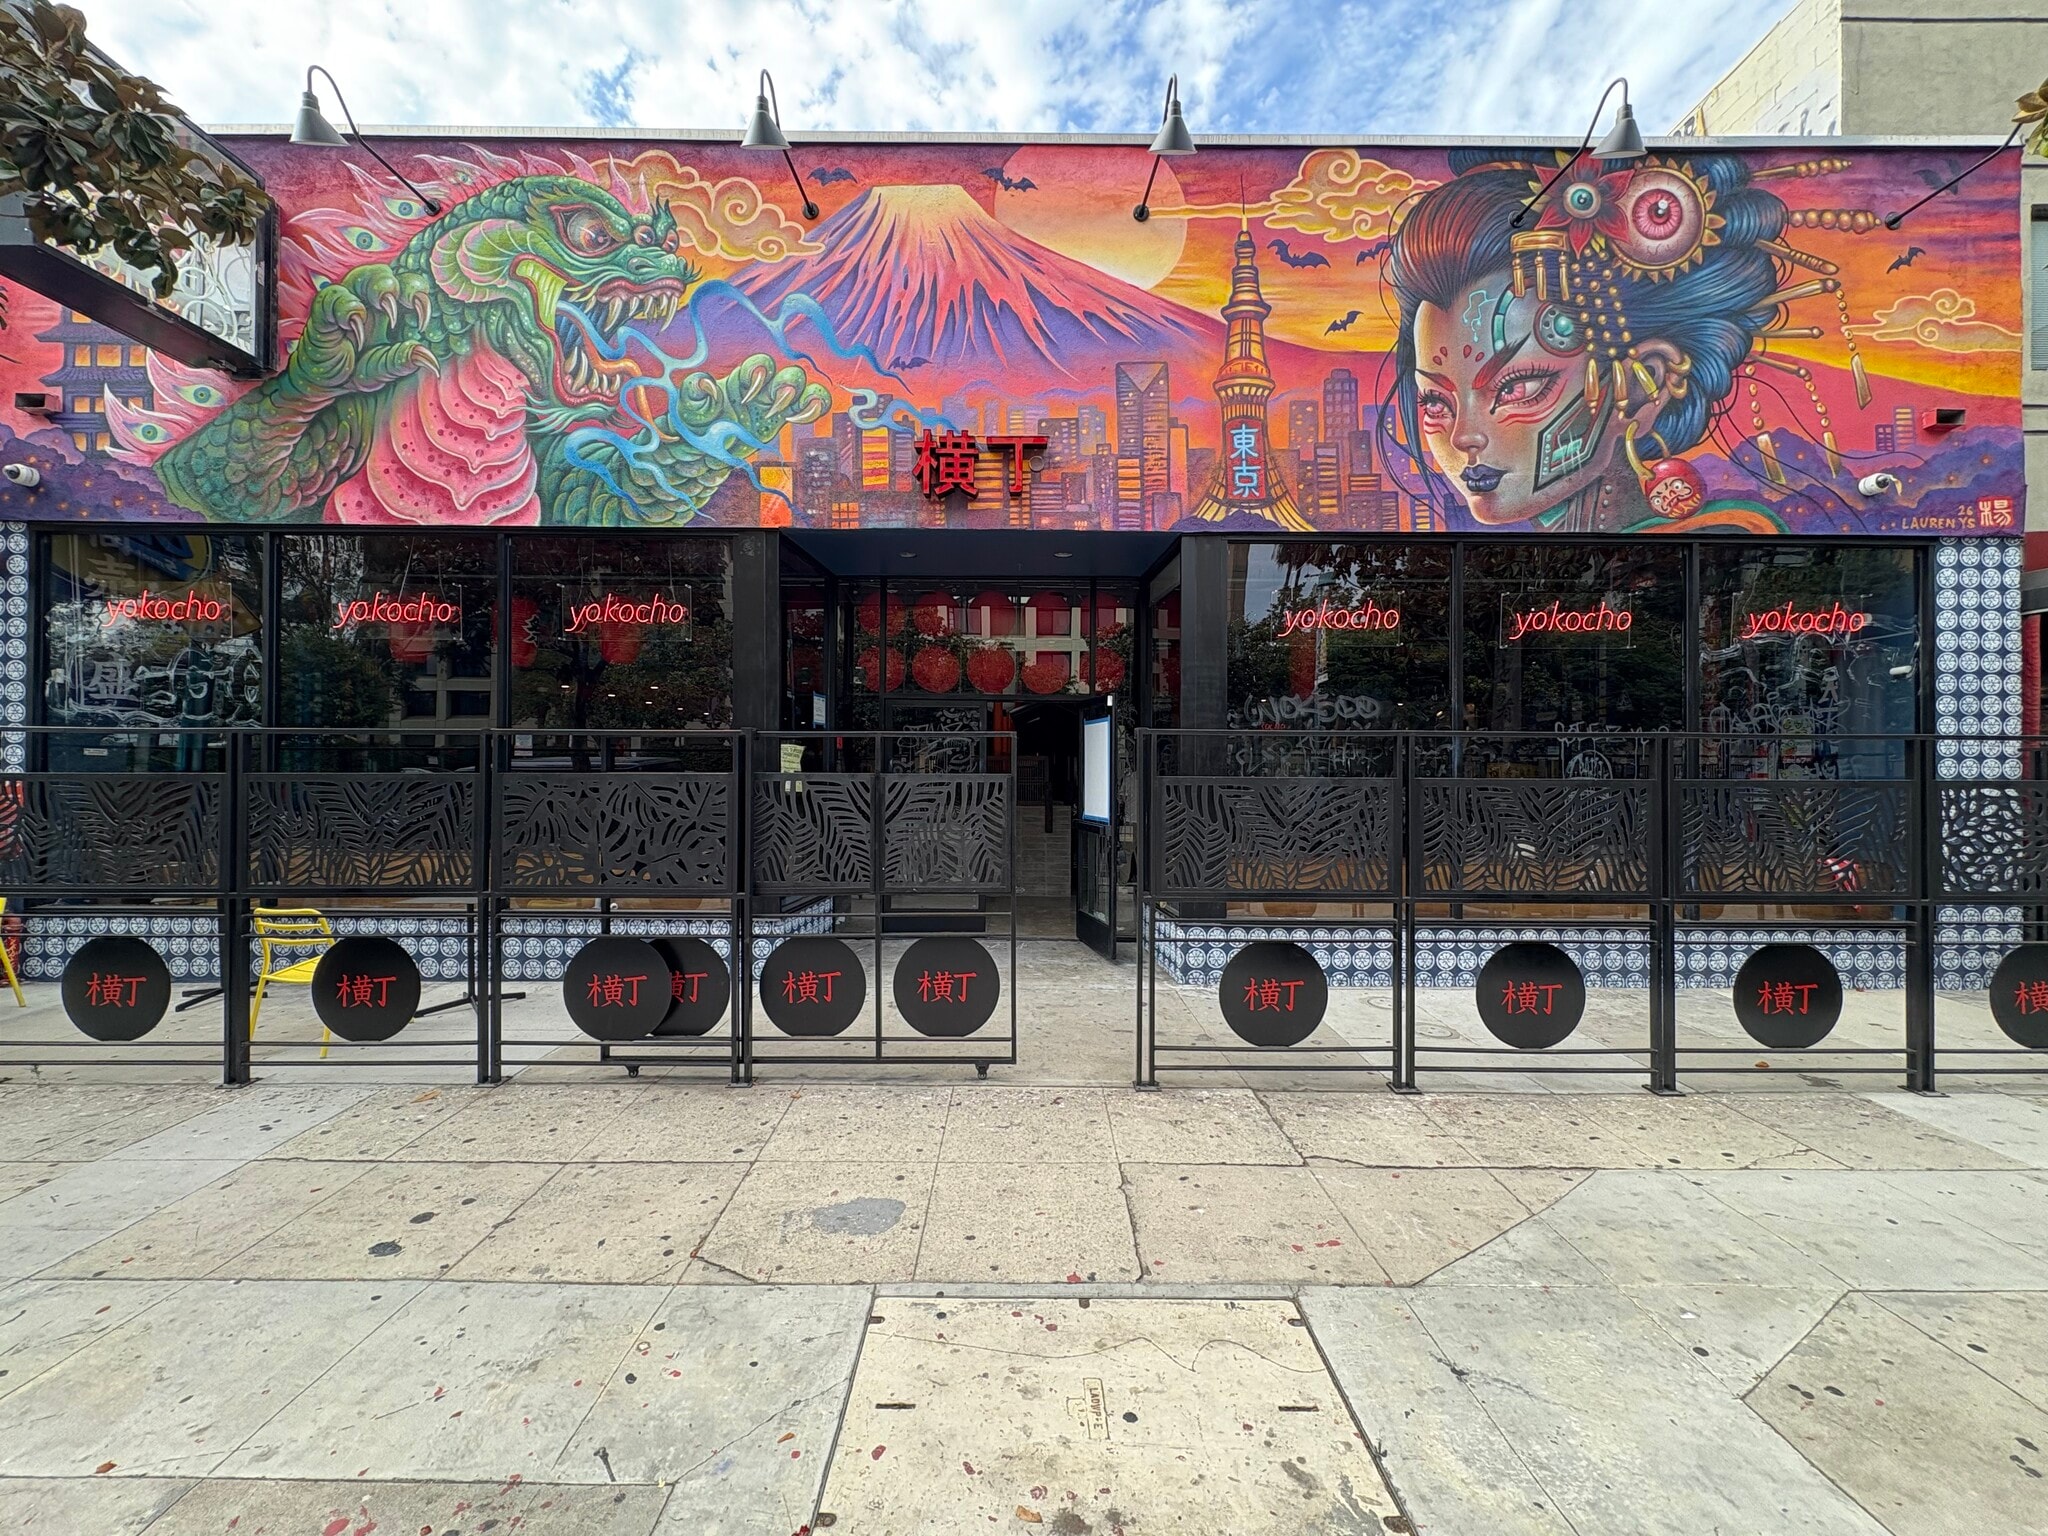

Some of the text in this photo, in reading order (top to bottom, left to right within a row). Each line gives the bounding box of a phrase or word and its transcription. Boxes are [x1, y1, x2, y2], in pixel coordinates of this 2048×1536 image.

[912, 429, 1049, 499] 横丁
[1229, 423, 1262, 498] 東京
[1902, 517, 1976, 529] LAUREN YS
[1958, 505, 1974, 516] 26
[102, 590, 221, 628] yokocho
[332, 591, 454, 629] yokocho
[564, 593, 684, 632] yokocho
[1277, 598, 1401, 637] yokocho
[1508, 600, 1632, 640] yokocho
[1741, 601, 1866, 638] yokocho
[84, 971, 148, 1009] 横丁
[335, 973, 398, 1009] 横丁
[586, 972, 648, 1008] 横丁
[781, 970, 842, 1005] 横丁
[916, 970, 977, 1004] 横丁
[1243, 977, 1305, 1012] 横丁
[1500, 980, 1563, 1016] 横丁
[1756, 980, 1819, 1016] 横丁
